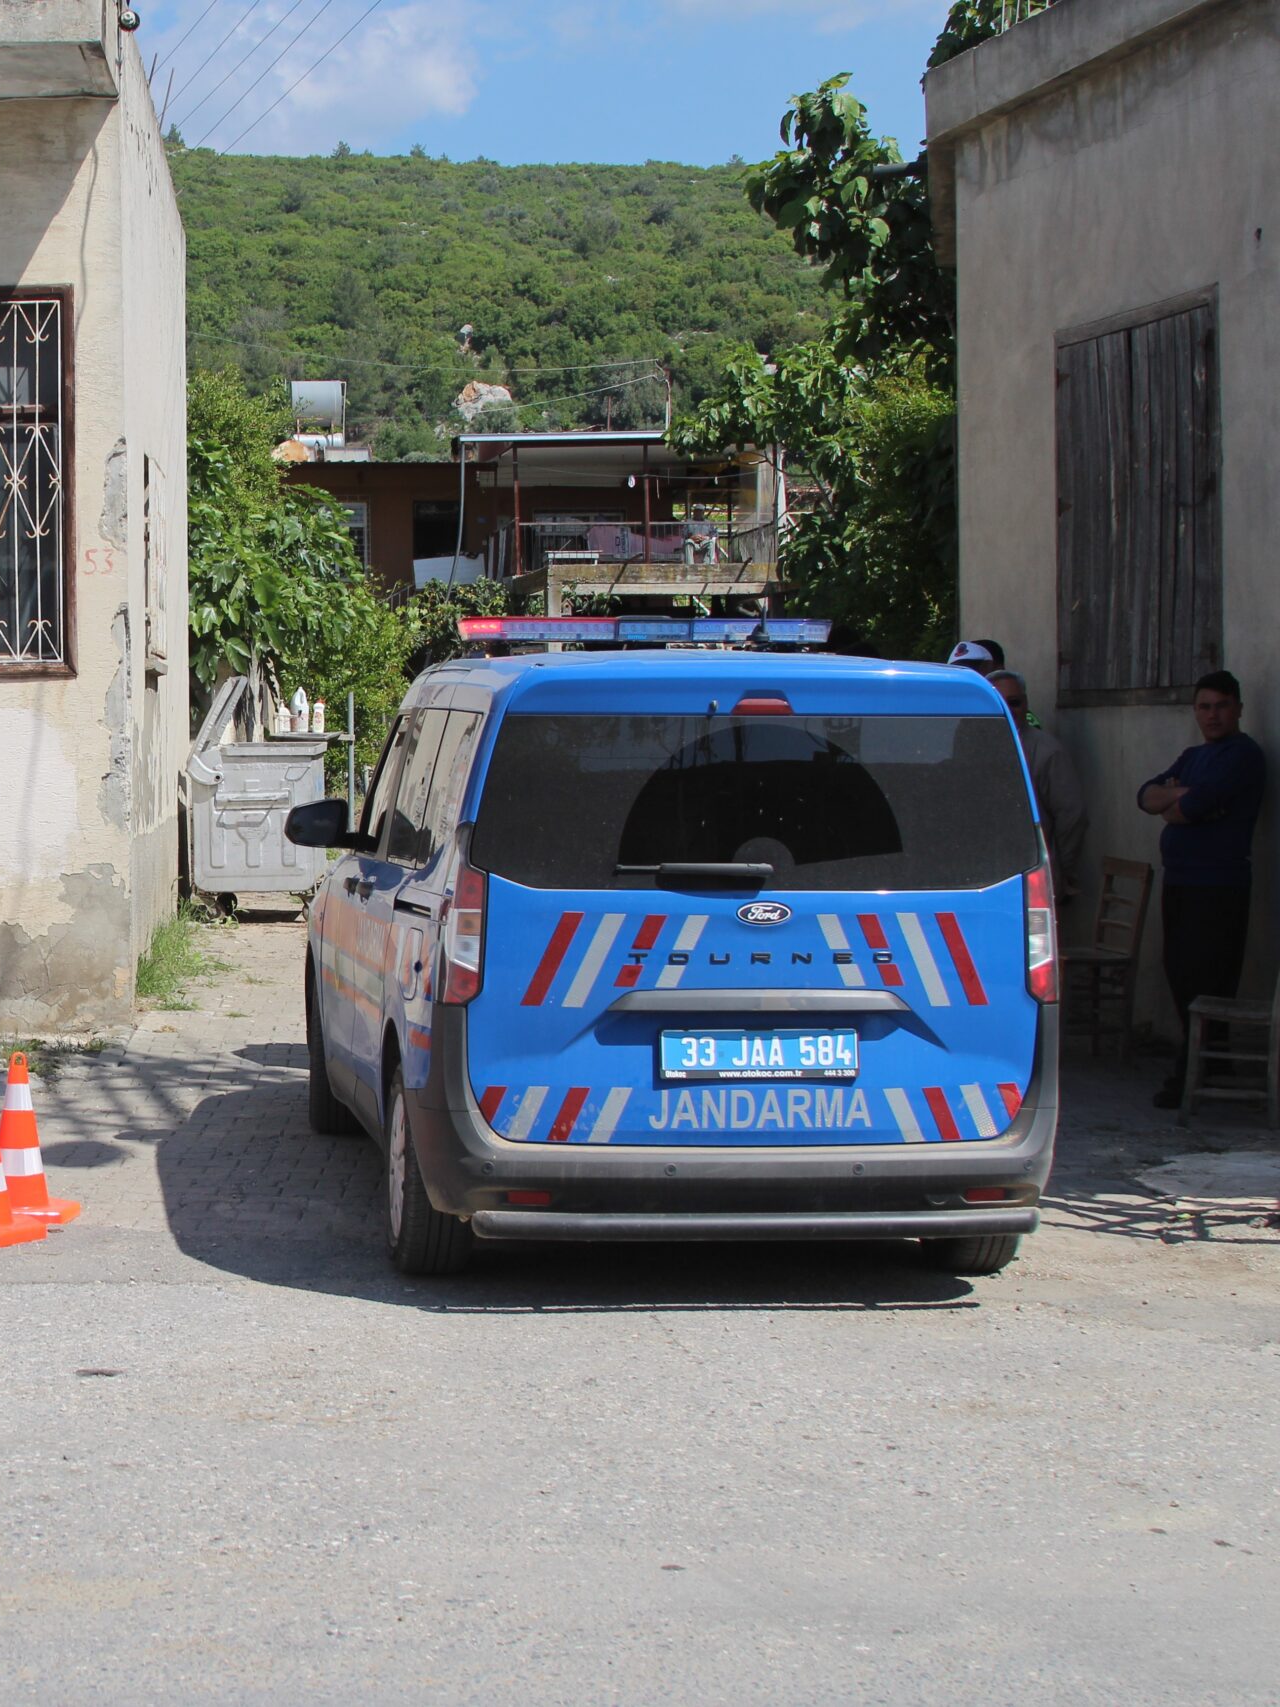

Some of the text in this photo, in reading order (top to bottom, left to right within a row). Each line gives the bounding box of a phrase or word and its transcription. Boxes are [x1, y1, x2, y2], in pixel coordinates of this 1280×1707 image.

[83, 548, 113, 576] 53
[747, 905, 781, 921] Ford
[628, 951, 894, 965] TOURNEO
[681, 1035, 852, 1067] 33 JAA 584
[719, 1069, 803, 1079] www.otokoc.com.tr
[649, 1088, 872, 1129] JANDARMA
